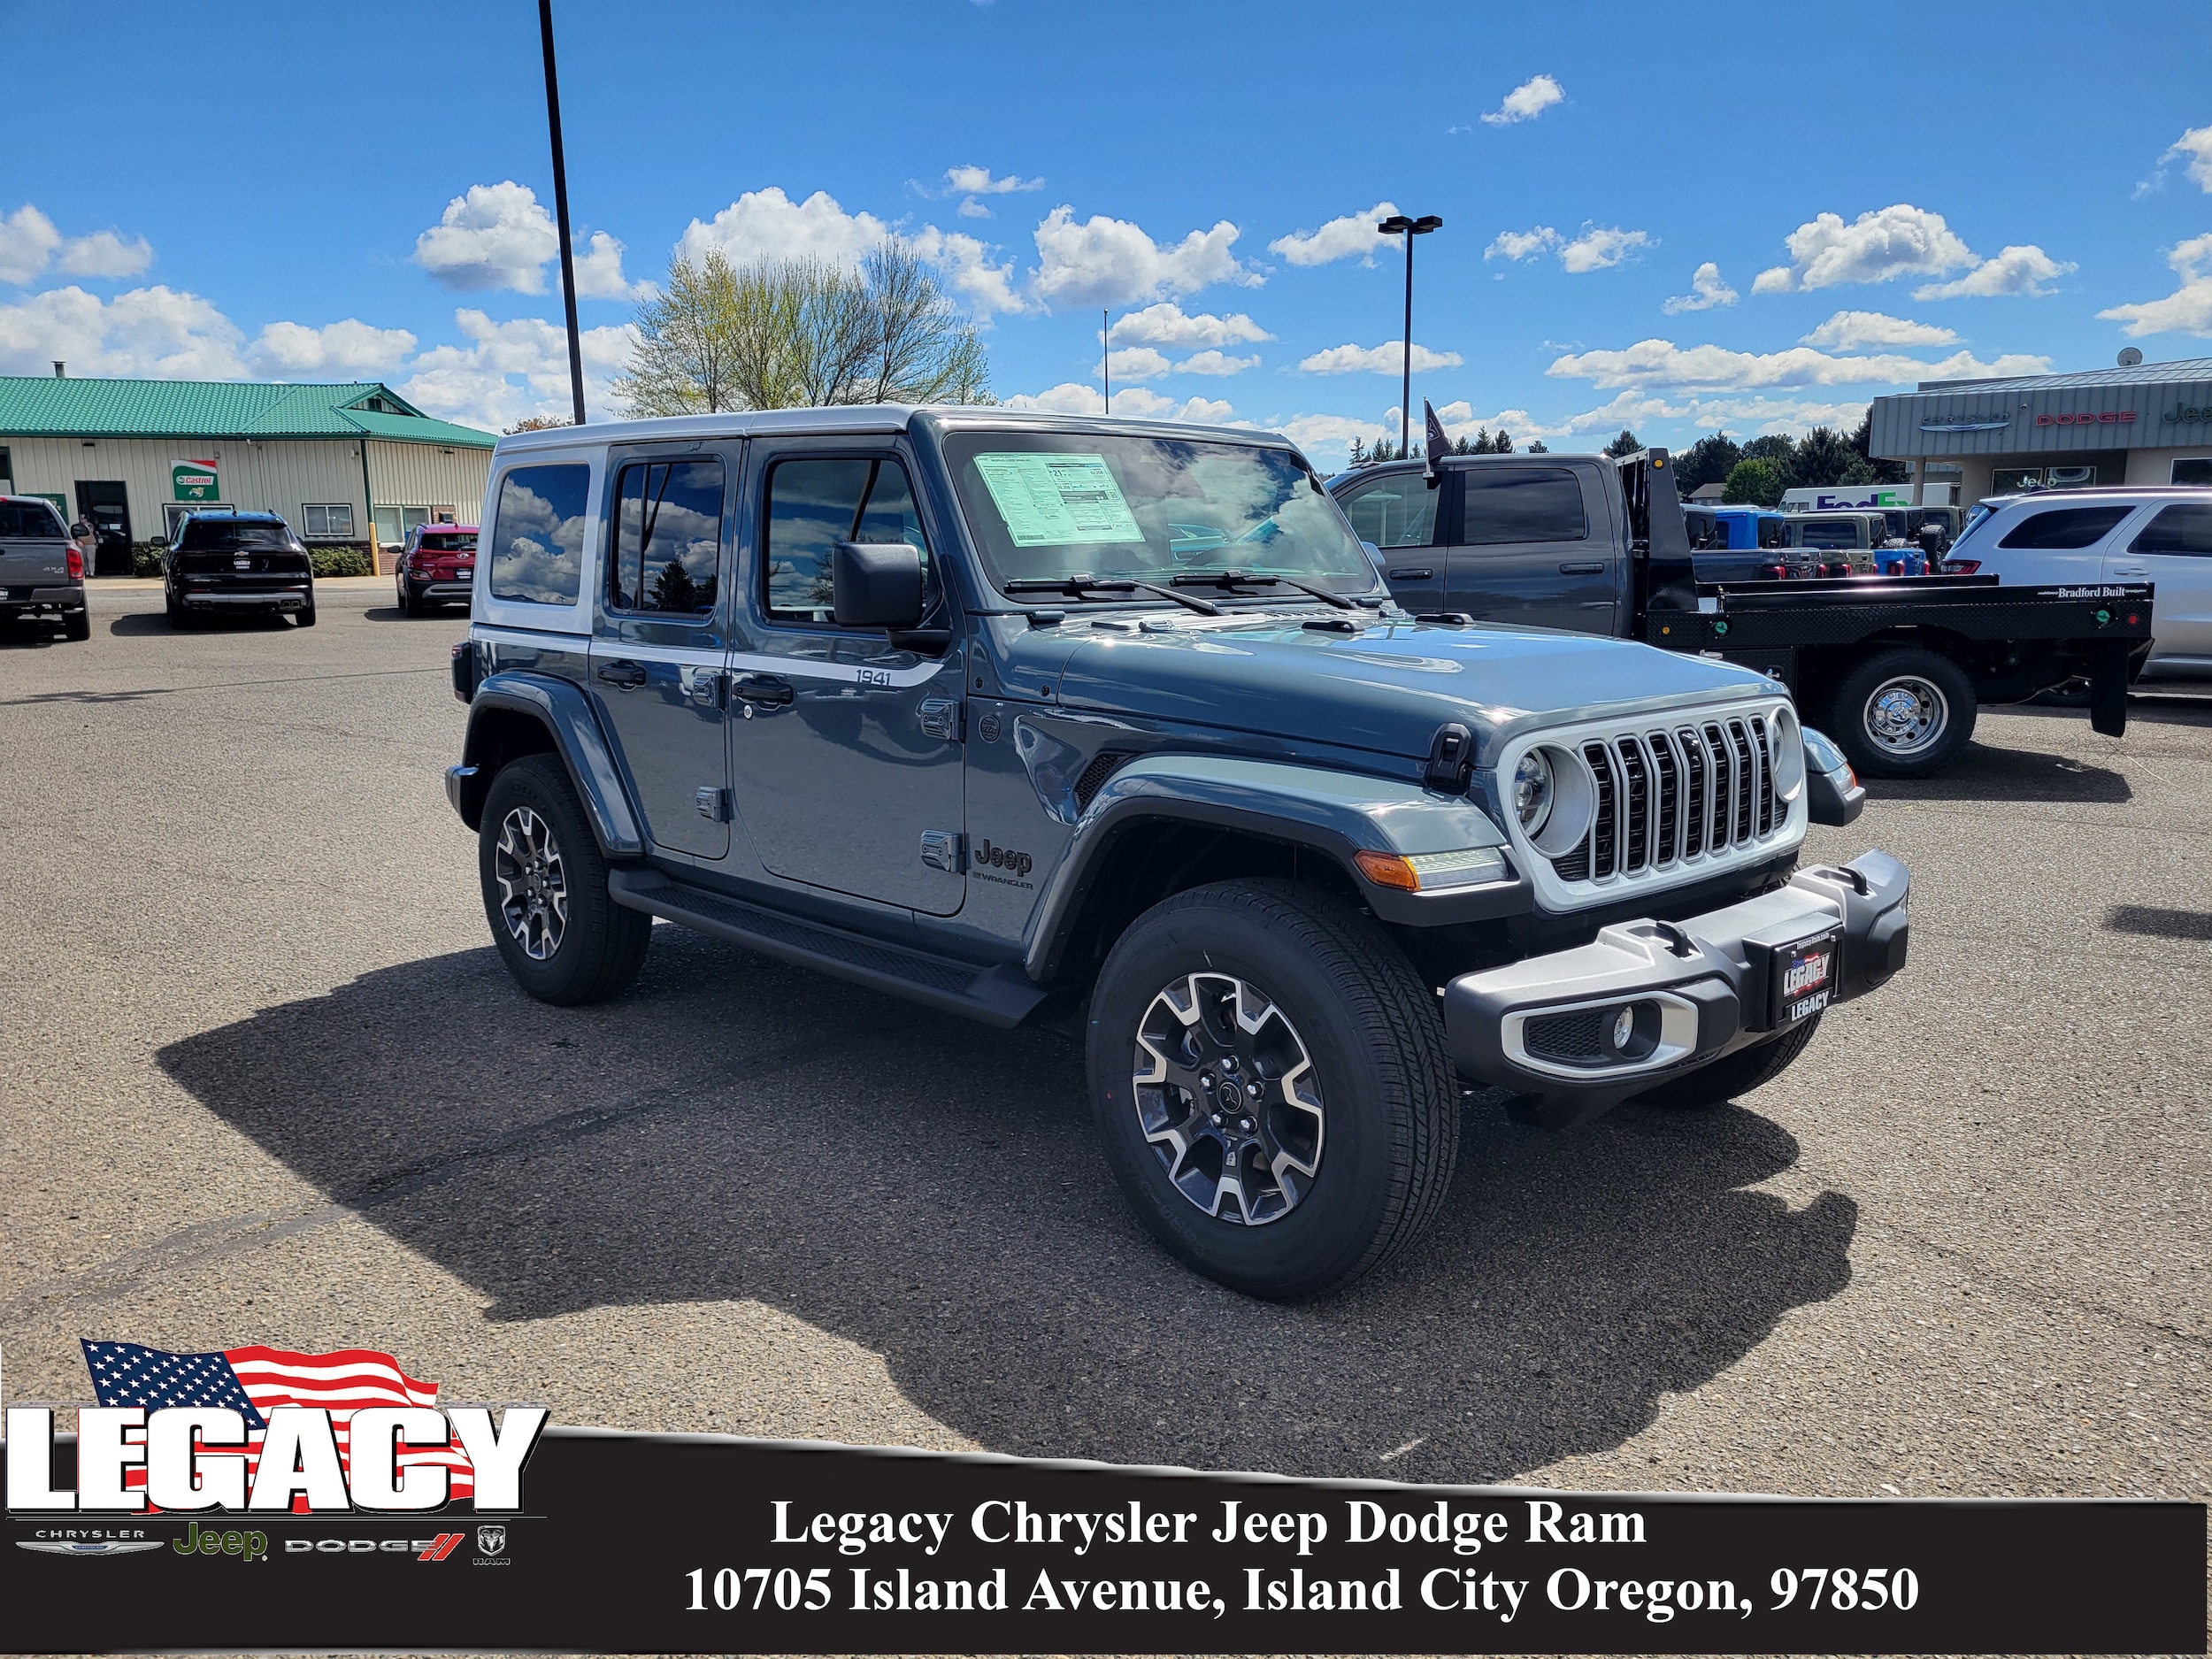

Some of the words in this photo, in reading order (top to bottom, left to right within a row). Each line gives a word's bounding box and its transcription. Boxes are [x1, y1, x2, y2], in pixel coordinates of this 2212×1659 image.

[2036, 411, 2138, 426] DODGE
[2162, 402, 2212, 424] Jee
[2057, 588, 2101, 598] Bradford
[2101, 587, 2125, 597] Built
[856, 669, 891, 686] 1941
[974, 838, 1033, 878] Jeep
[981, 872, 1034, 890] WRANGLER
[1784, 955, 1831, 995] LEGACY
[1791, 990, 1830, 1022] LEGACY
